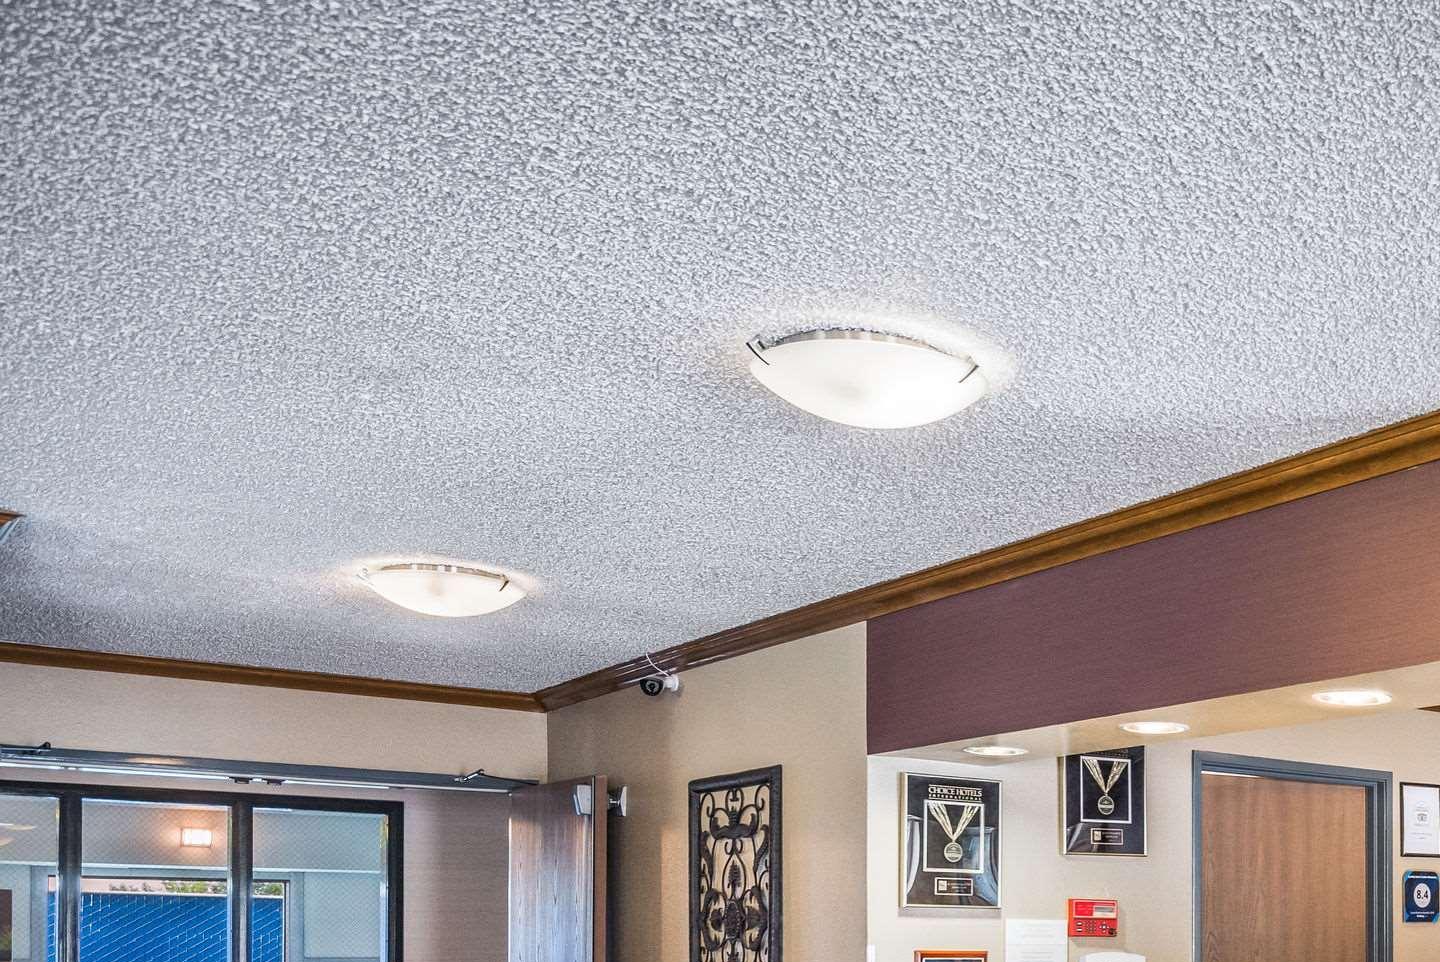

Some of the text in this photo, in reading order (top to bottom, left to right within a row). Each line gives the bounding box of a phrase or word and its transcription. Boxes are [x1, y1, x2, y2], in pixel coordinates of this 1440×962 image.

[928, 786, 955, 795] CHOICE
[956, 788, 983, 797] HOTELS
[1416, 889, 1428, 900] 8.4
